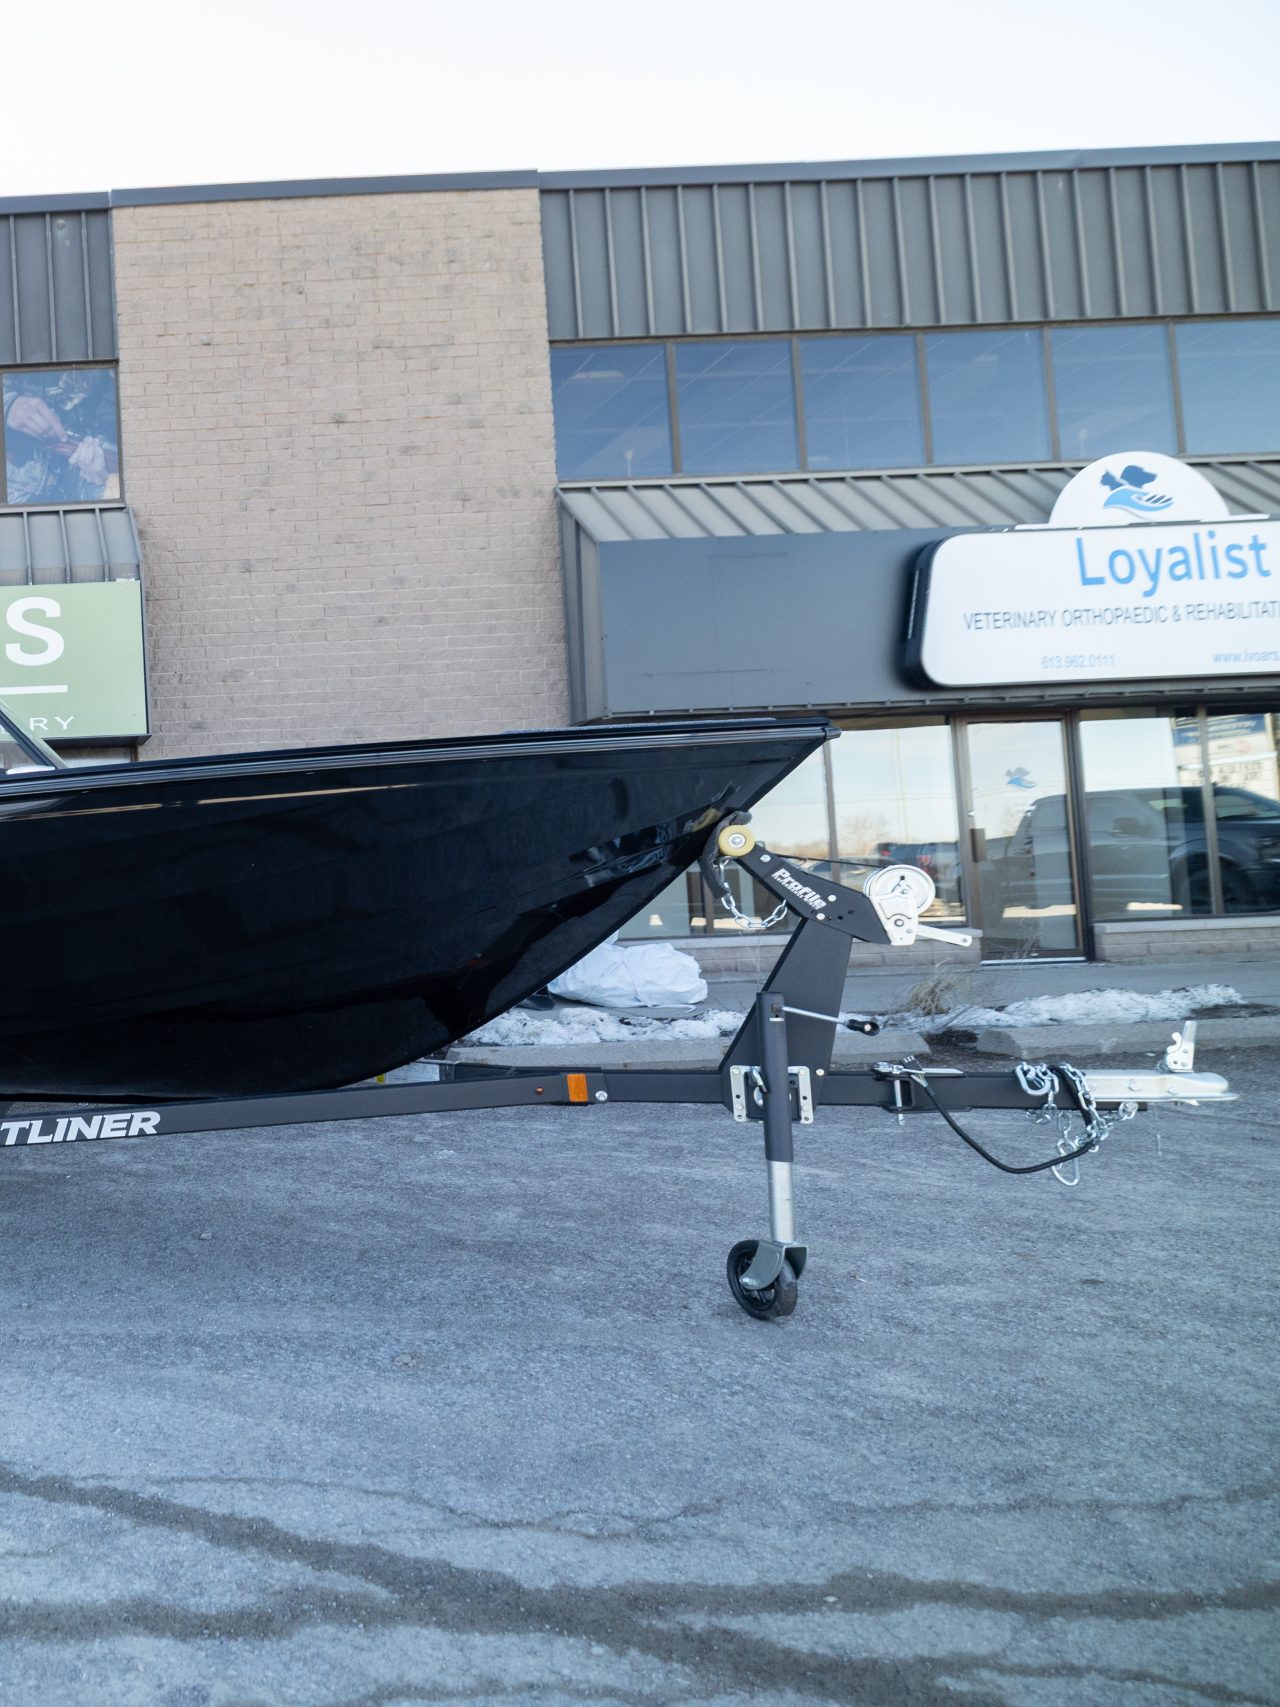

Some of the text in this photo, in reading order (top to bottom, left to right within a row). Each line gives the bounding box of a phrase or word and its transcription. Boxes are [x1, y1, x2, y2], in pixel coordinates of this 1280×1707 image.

[1075, 529, 1272, 598] Loyalist
[963, 609, 1057, 631] VETERINARY
[1061, 604, 1169, 627] ORTHOPAEDIC
[772, 868, 827, 910] Profile
